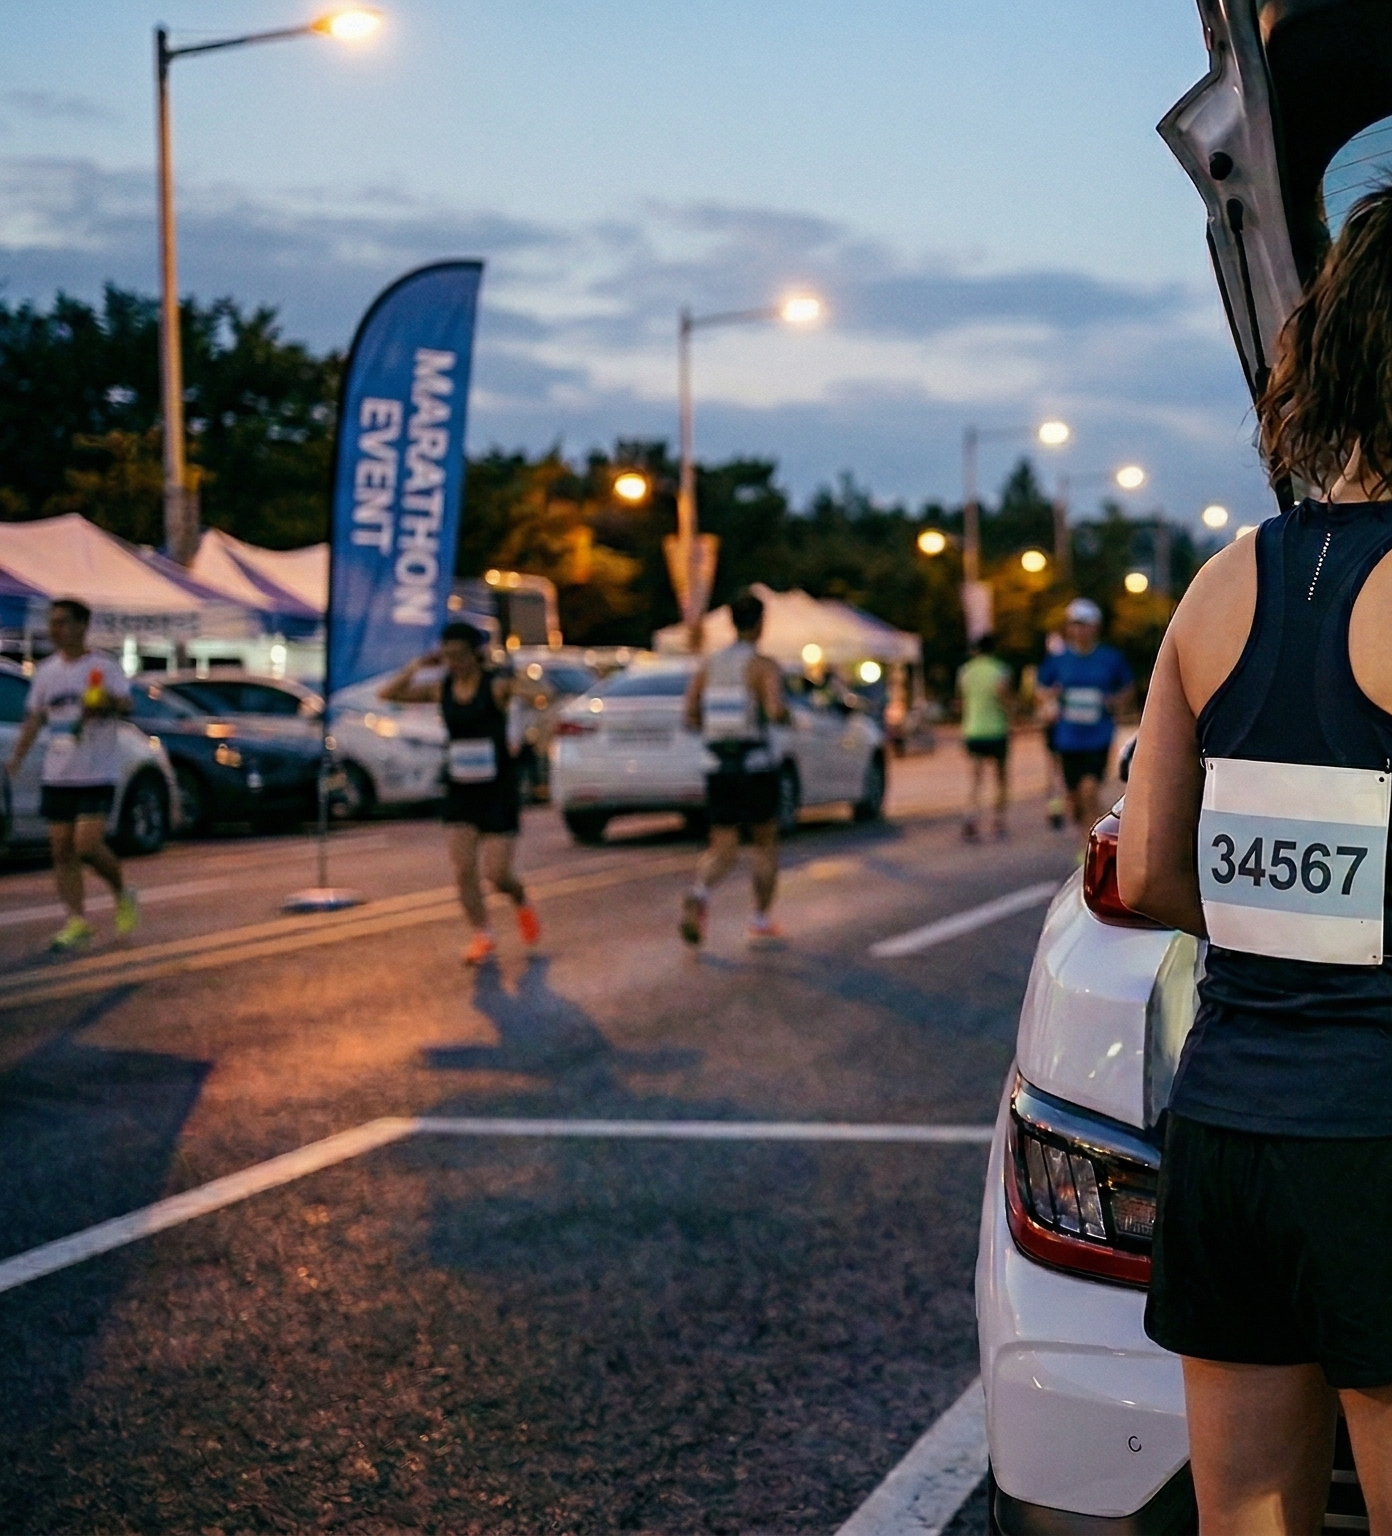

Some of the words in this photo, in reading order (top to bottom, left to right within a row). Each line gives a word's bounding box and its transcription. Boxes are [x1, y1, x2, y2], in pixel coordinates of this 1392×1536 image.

[351, 398, 401, 556] EVENT
[392, 349, 455, 626] MARATHON
[1211, 834, 1368, 896] 34567
